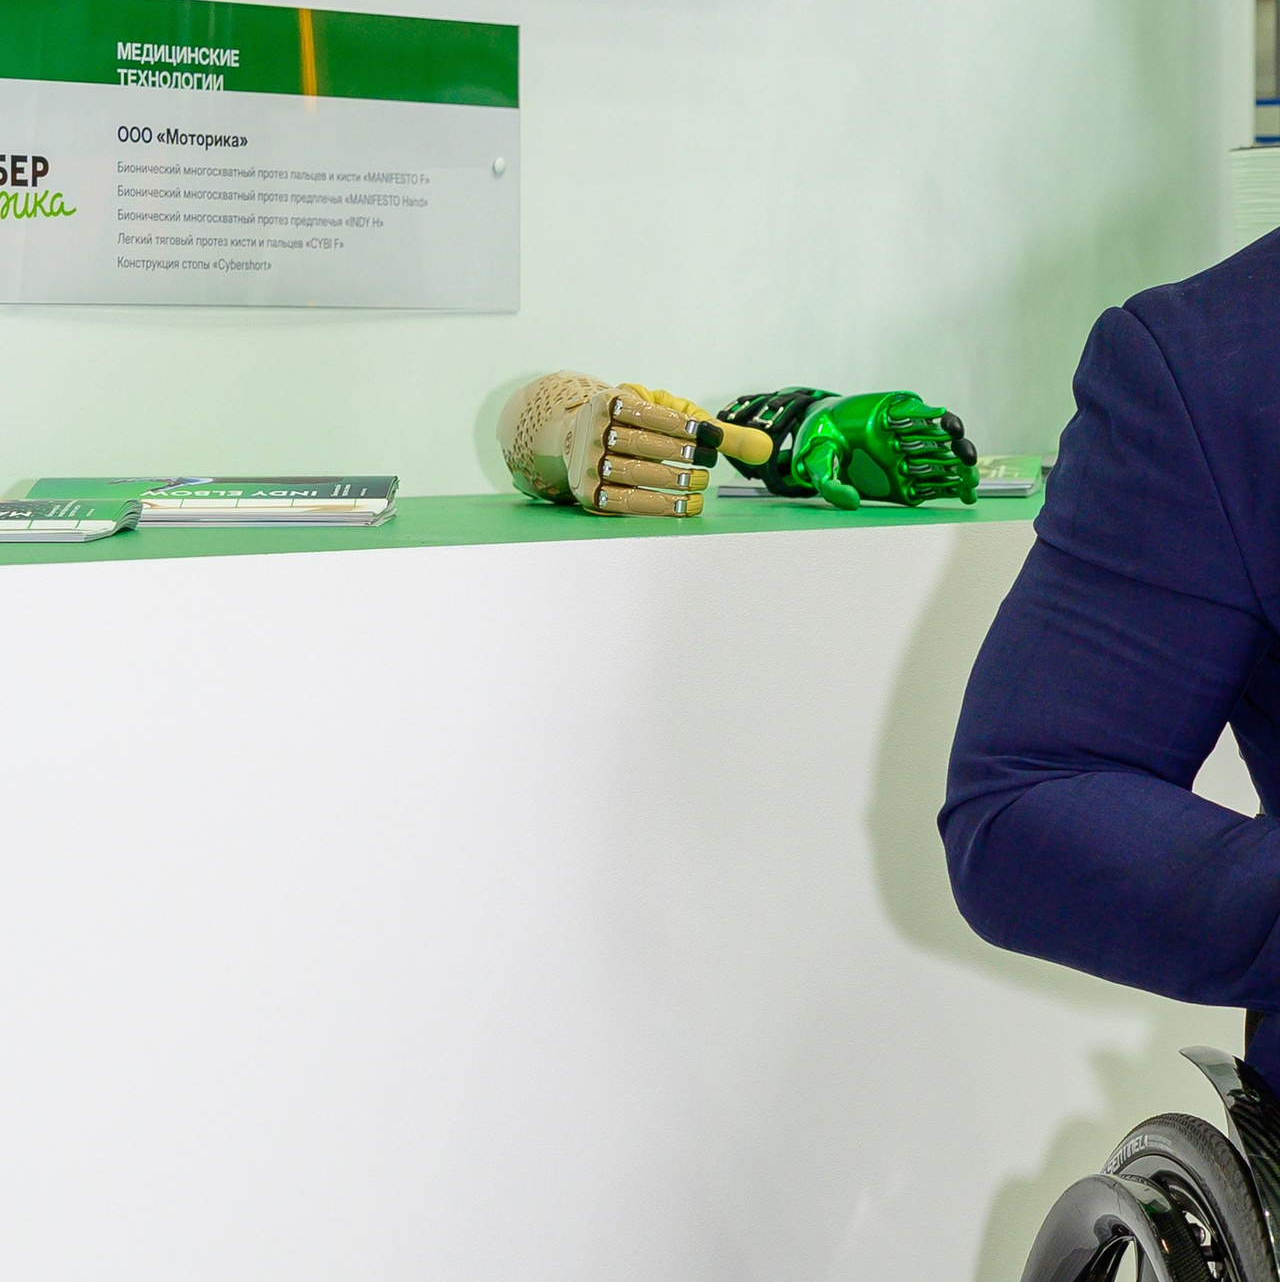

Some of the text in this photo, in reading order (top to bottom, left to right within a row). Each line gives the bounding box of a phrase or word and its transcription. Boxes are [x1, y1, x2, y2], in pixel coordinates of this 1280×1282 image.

[117, 42, 240, 67] МЕДИЦИНСКИЕ
[117, 69, 224, 91] ТЕХНОЛОГИИ
[117, 126, 248, 151] ООО «Моторика»
[117, 161, 181, 175] Бионический
[183, 165, 256, 179] многосхватный
[258, 169, 289, 181] протез
[290, 171, 326, 182] пальцев
[336, 173, 361, 182] кисти
[117, 185, 181, 199] Бионический
[183, 189, 256, 202] многосхватный
[258, 192, 289, 204] протез
[290, 194, 343, 206] предплечья
[117, 209, 181, 223] Бионический
[183, 213, 256, 226] многосхватный
[258, 216, 289, 228] протез
[290, 217, 343, 229] предплечья
[117, 232, 153, 245] Легкий
[155, 234, 194, 246] тяговый
[196, 237, 228, 249] протез
[230, 238, 256, 247] кисти
[266, 239, 303, 250] пальцев
[117, 256, 272, 273] Конструкция стопы «Cybershort»
